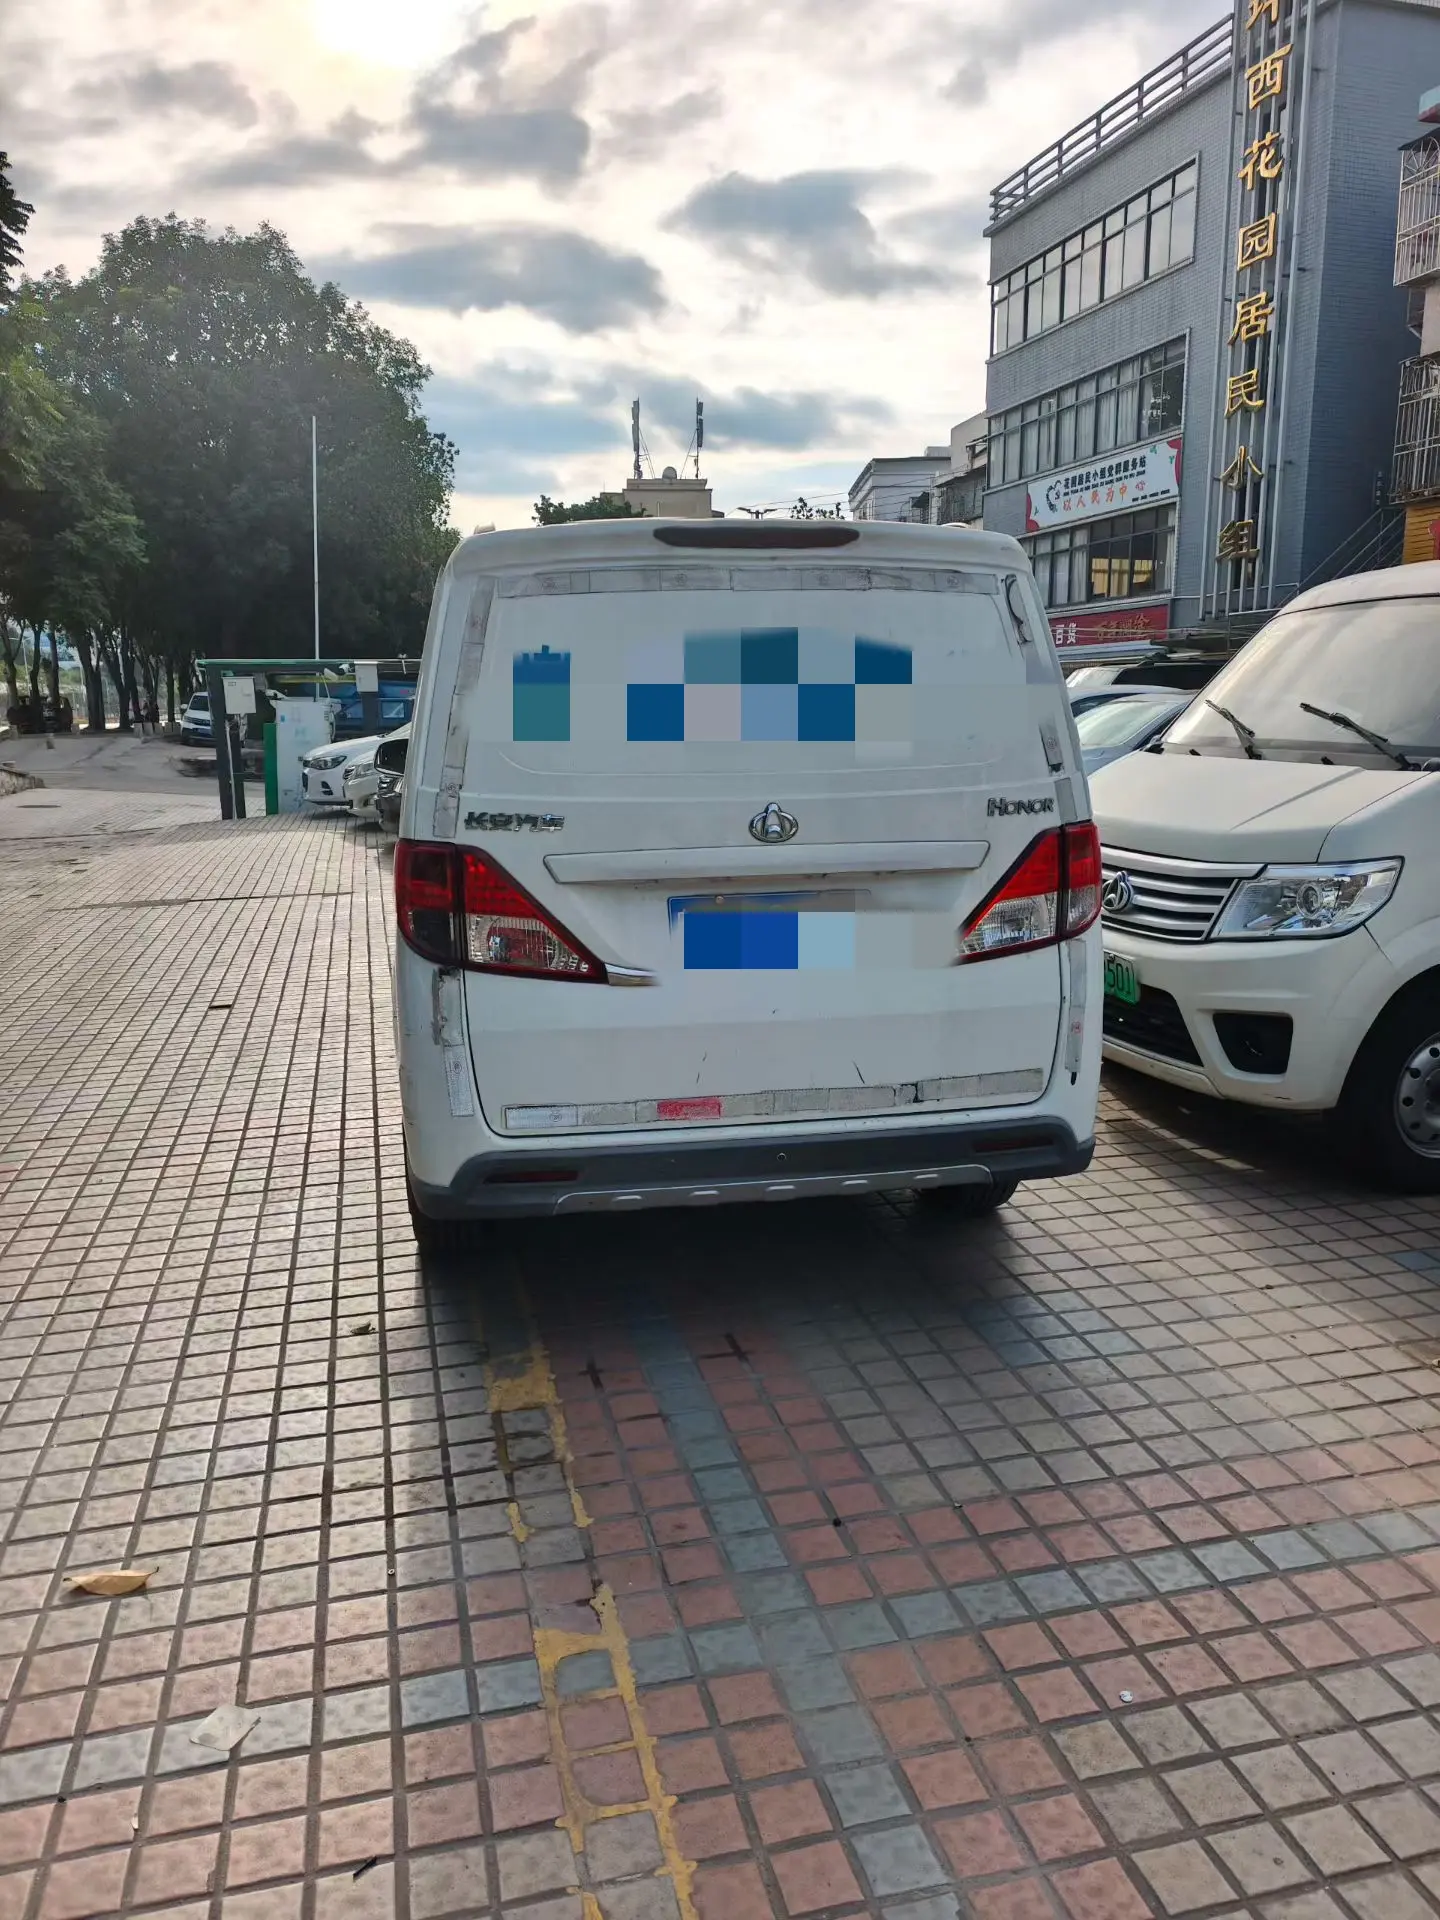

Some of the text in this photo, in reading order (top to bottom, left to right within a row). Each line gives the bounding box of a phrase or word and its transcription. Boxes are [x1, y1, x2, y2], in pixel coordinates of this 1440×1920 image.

[987, 797, 1055, 817] HONOR
[464, 811, 565, 832] 长安汽车
[1104, 959, 1131, 994] 501
